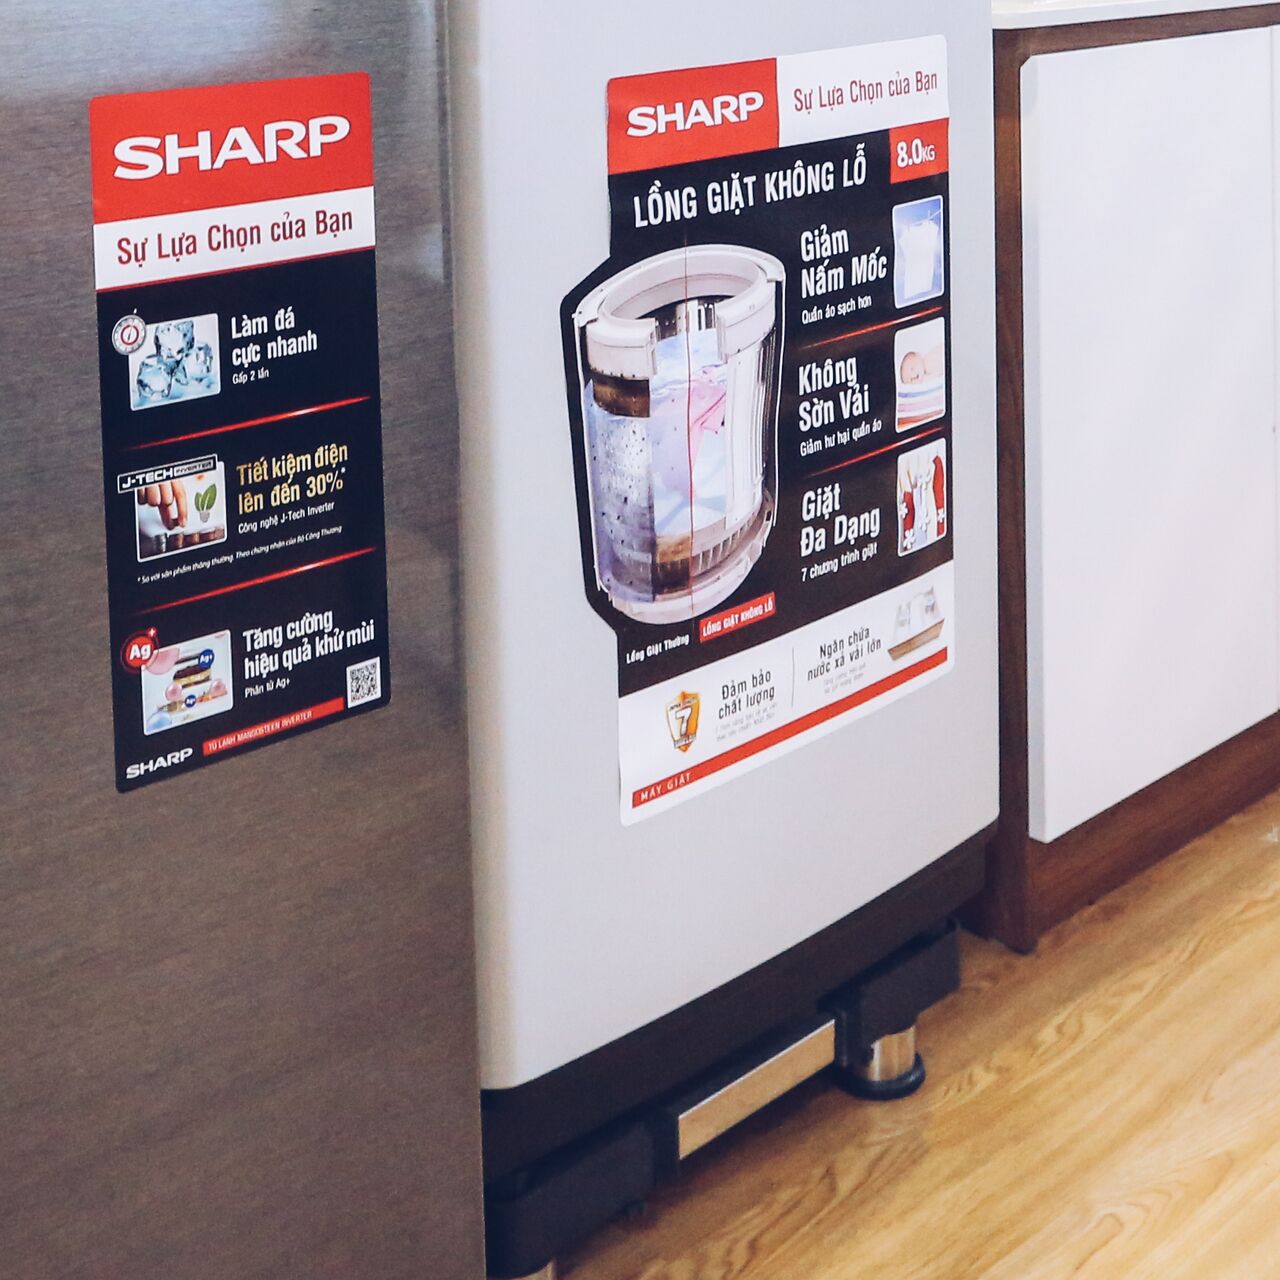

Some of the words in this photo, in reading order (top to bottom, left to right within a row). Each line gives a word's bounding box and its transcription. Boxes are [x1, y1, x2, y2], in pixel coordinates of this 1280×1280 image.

[794, 88, 813, 115] Sự
[819, 85, 844, 111] Lựa
[850, 79, 883, 104] Chọn
[889, 71, 910, 97] của
[915, 70, 938, 95] Bạn
[626, 91, 764, 137] SHARP
[113, 115, 351, 180] SHARP
[633, 179, 697, 228] LỒNG
[707, 172, 757, 216] GIẶT
[765, 160, 835, 203] KHÔNG
[843, 143, 867, 188] LỖ
[117, 237, 148, 267] Sự
[157, 232, 197, 262] Lựa
[207, 223, 261, 253] Chọn
[271, 211, 306, 242] của
[316, 209, 353, 238] Bạn
[800, 223, 849, 262] Giảm
[801, 259, 844, 299] Nấm
[851, 246, 888, 286] Mốc
[231, 314, 268, 339] Làm
[275, 306, 295, 331] đá
[232, 343, 260, 368] cực
[267, 330, 317, 359] nhanh
[250, 370, 256, 381] 2
[798, 356, 858, 396] Không
[798, 397, 834, 432] Sờn
[839, 384, 869, 420] Vải
[122, 467, 173, 488] J-TECH
[236, 456, 269, 486] Tiết
[272, 453, 311, 478] kiệm
[314, 443, 348, 468] điện
[238, 491, 264, 515] lên
[270, 473, 300, 507] đến
[307, 502, 335, 516] Inverter
[801, 482, 841, 522] Giặt
[800, 525, 826, 558] Đa
[834, 507, 881, 546] Dạng
[801, 567, 807, 582] 7
[242, 625, 283, 652] Tăng
[286, 610, 333, 640] cường
[244, 652, 279, 679] hiệu
[282, 637, 312, 671] quả
[315, 627, 344, 658] khử
[346, 619, 375, 648] mùi
[675, 705, 693, 736] 7
[126, 747, 194, 779] SHARP
